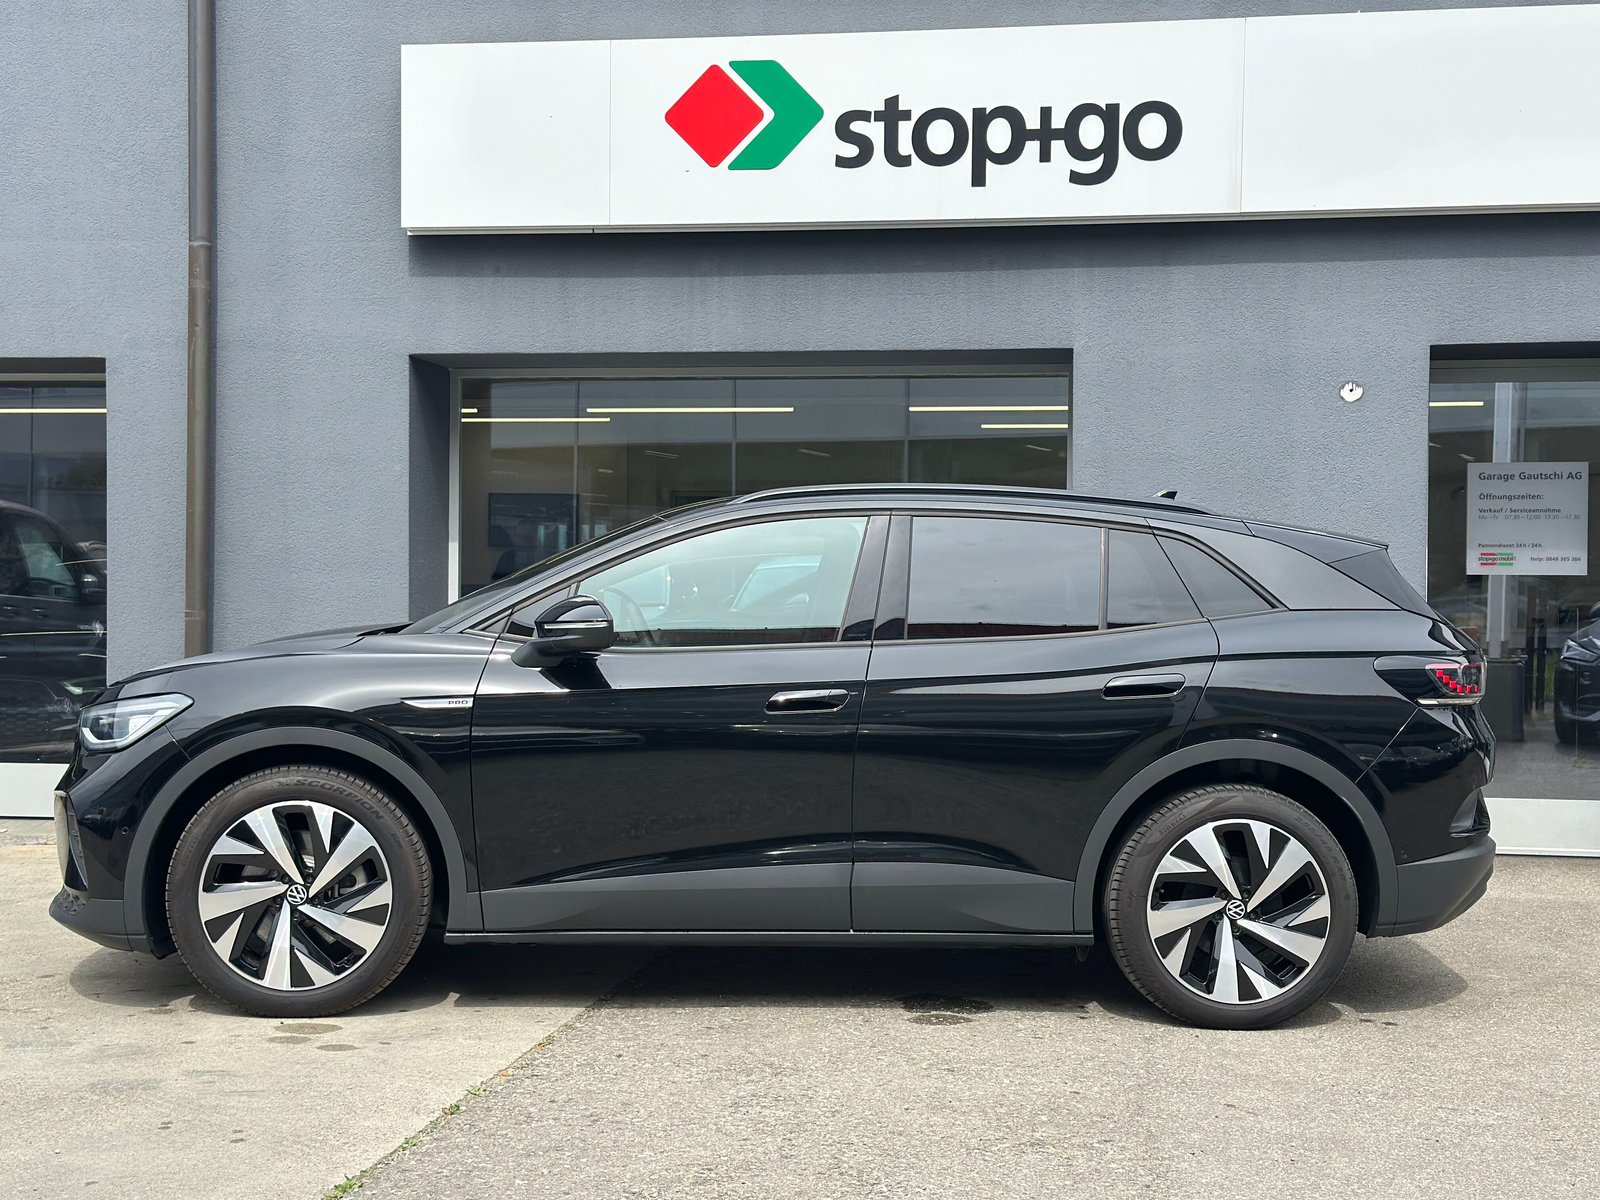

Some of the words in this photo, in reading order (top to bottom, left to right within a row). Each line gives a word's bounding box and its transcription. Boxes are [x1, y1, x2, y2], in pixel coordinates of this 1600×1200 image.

[834, 94, 1183, 188] stop+go
[1478, 472, 1516, 482] Garage
[1518, 471, 1564, 480] Gautschi
[1566, 471, 1583, 480] AG
[1478, 493, 1544, 501] Öffnungszeiten:
[294, 779, 385, 820] SCORPION
